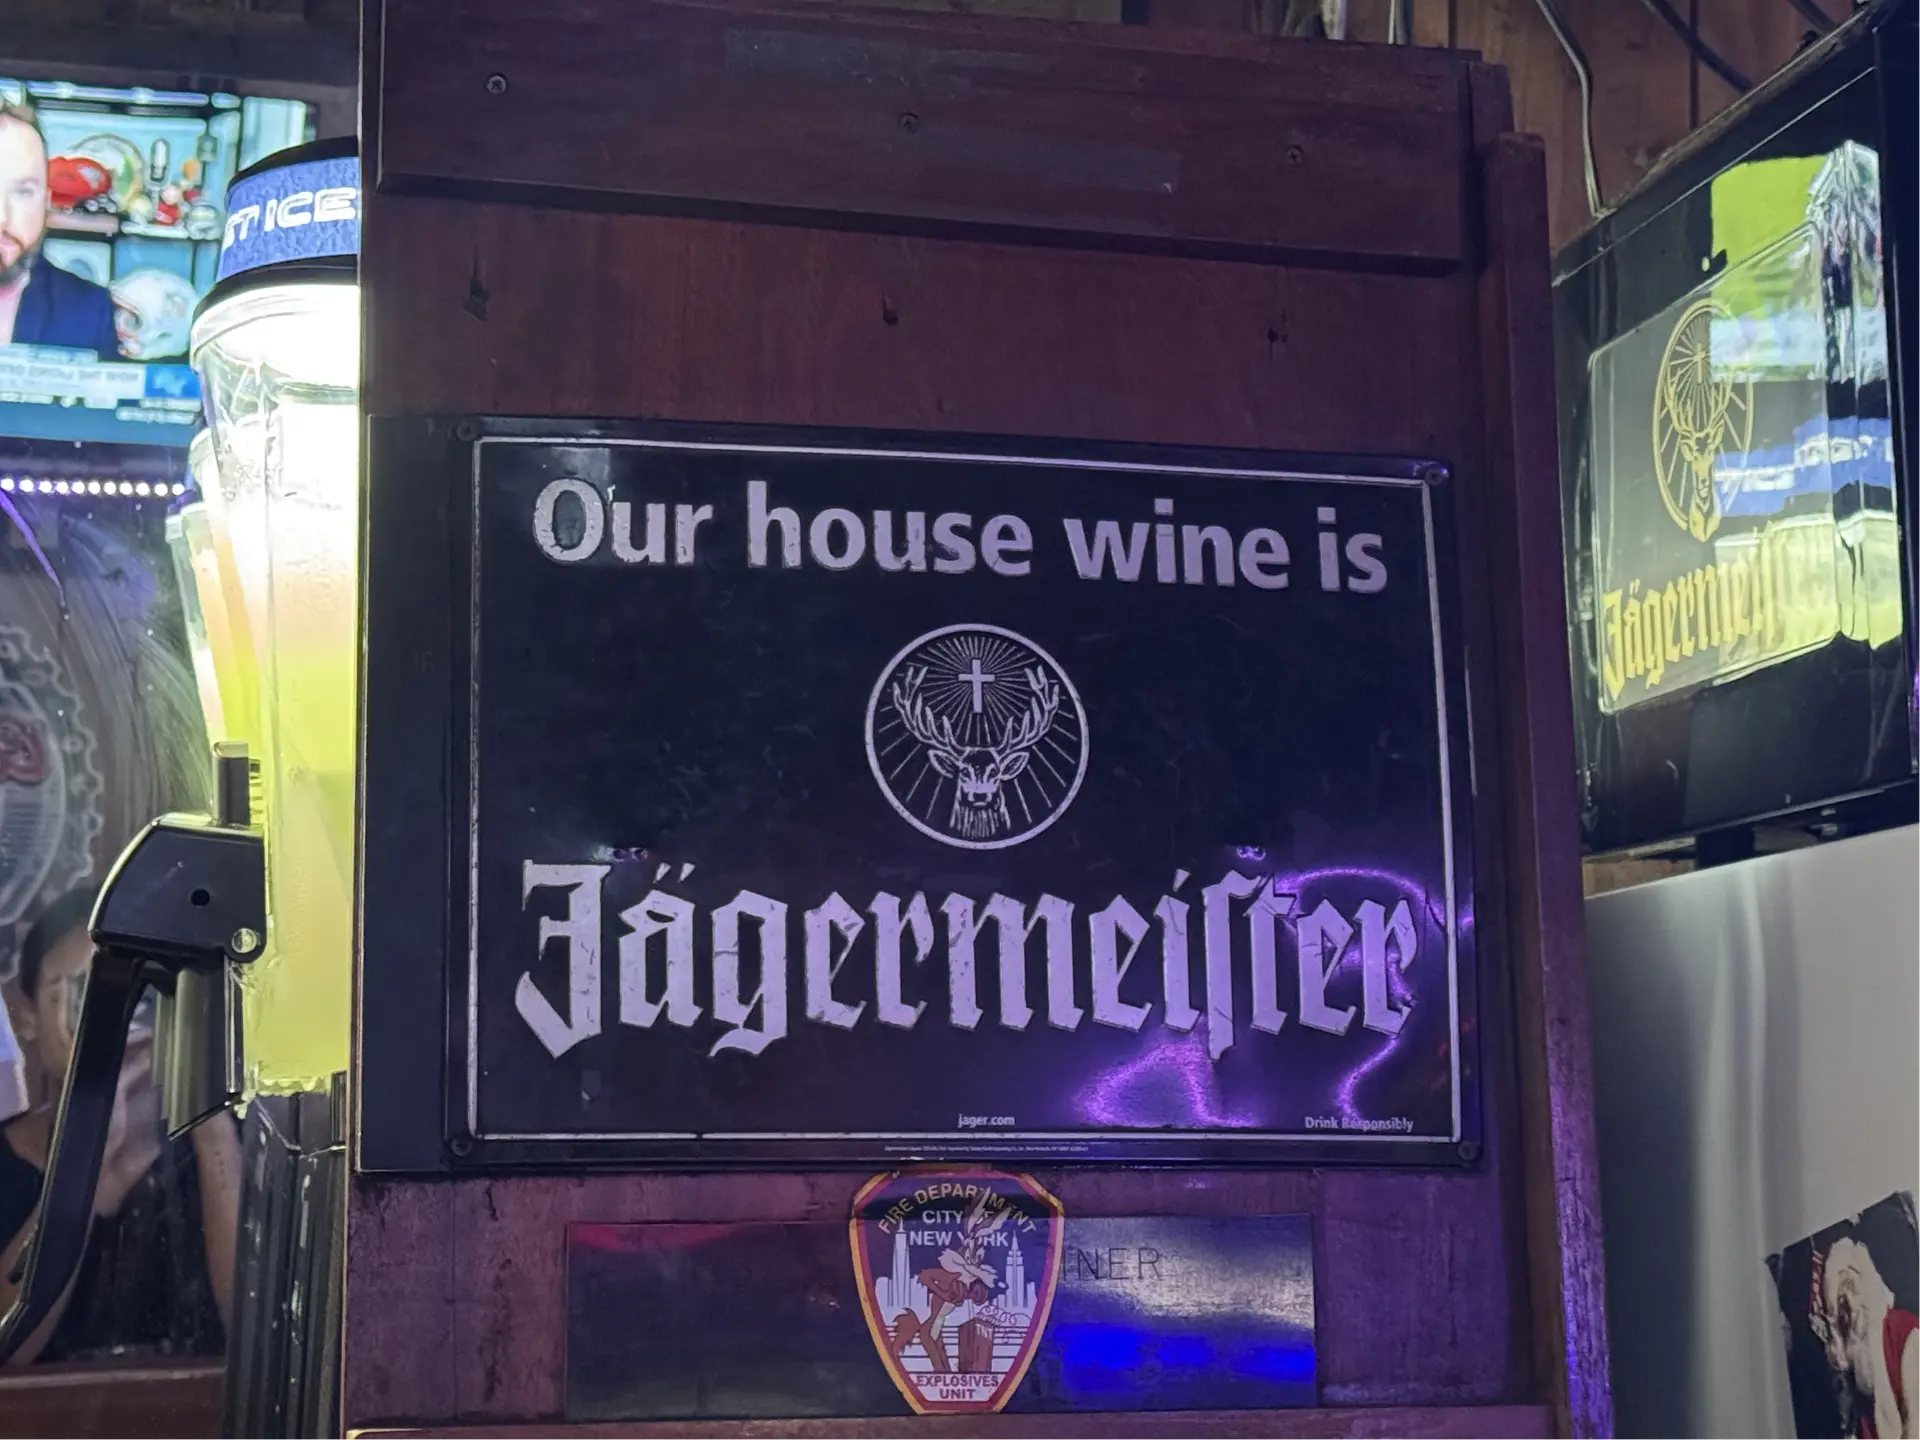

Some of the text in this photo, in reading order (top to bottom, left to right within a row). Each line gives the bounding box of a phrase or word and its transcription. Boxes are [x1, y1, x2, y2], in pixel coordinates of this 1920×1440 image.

[264, 187, 357, 232] ICE
[533, 477, 1388, 594] Our house wine is
[1602, 519, 1836, 702] Jägermeis
[515, 859, 1418, 1060] Jägermeister
[957, 1113, 1016, 1129] jager.com
[1304, 1116, 1414, 1133] Drink Responsibly
[878, 1183, 1037, 1234] FIRE DEPARMNT
[922, 1210, 964, 1225] CITY
[909, 1230, 1009, 1247] NEW RK
[974, 1323, 993, 1341] TNT
[916, 1375, 999, 1388] EXPLOSIVES
[940, 1388, 976, 1400] UNIT
